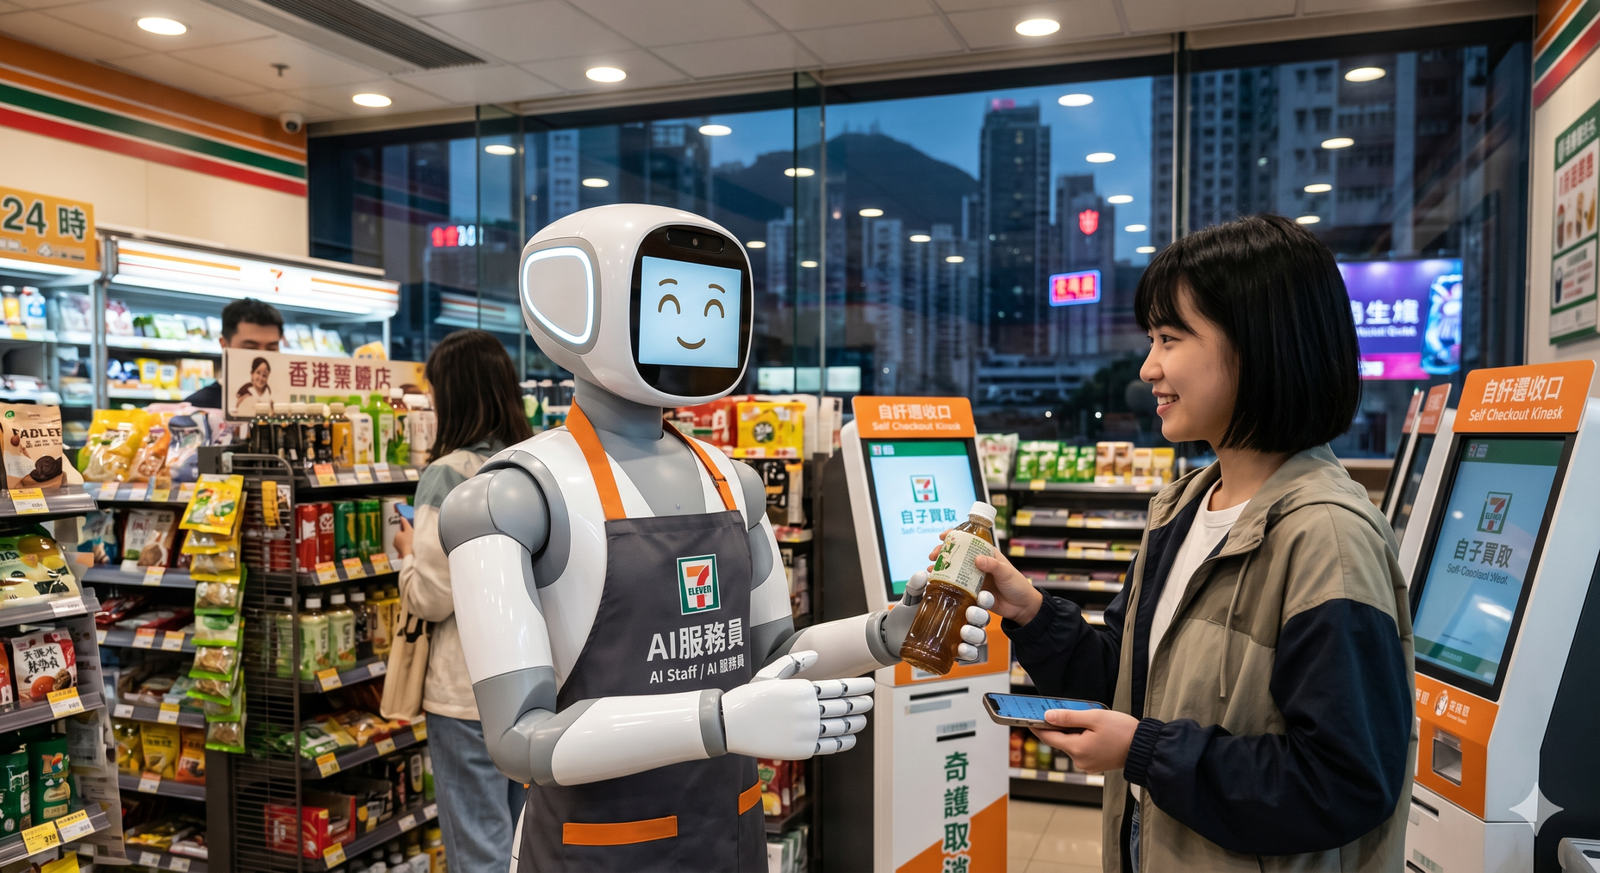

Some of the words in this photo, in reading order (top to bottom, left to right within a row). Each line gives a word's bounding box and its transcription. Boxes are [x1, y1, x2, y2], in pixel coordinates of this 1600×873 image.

[2, 196, 47, 235] 24
[58, 207, 86, 240] 時
[872, 421, 890, 431] Self
[892, 421, 933, 431] Checkout
[1468, 408, 1487, 421] Self
[1486, 407, 1530, 421] Checkout
[915, 478, 931, 501] 7
[901, 508, 957, 524] 自子買取
[1486, 497, 1507, 531] 7
[1453, 538, 1513, 568] 自子買取
[686, 565, 710, 609] 7
[688, 585, 712, 596] ELEVEN
[646, 617, 745, 662] AI服務員
[649, 670, 663, 684] AI
[667, 664, 698, 682] Staff
[706, 662, 717, 676] AI
[719, 653, 745, 674] 服務員
